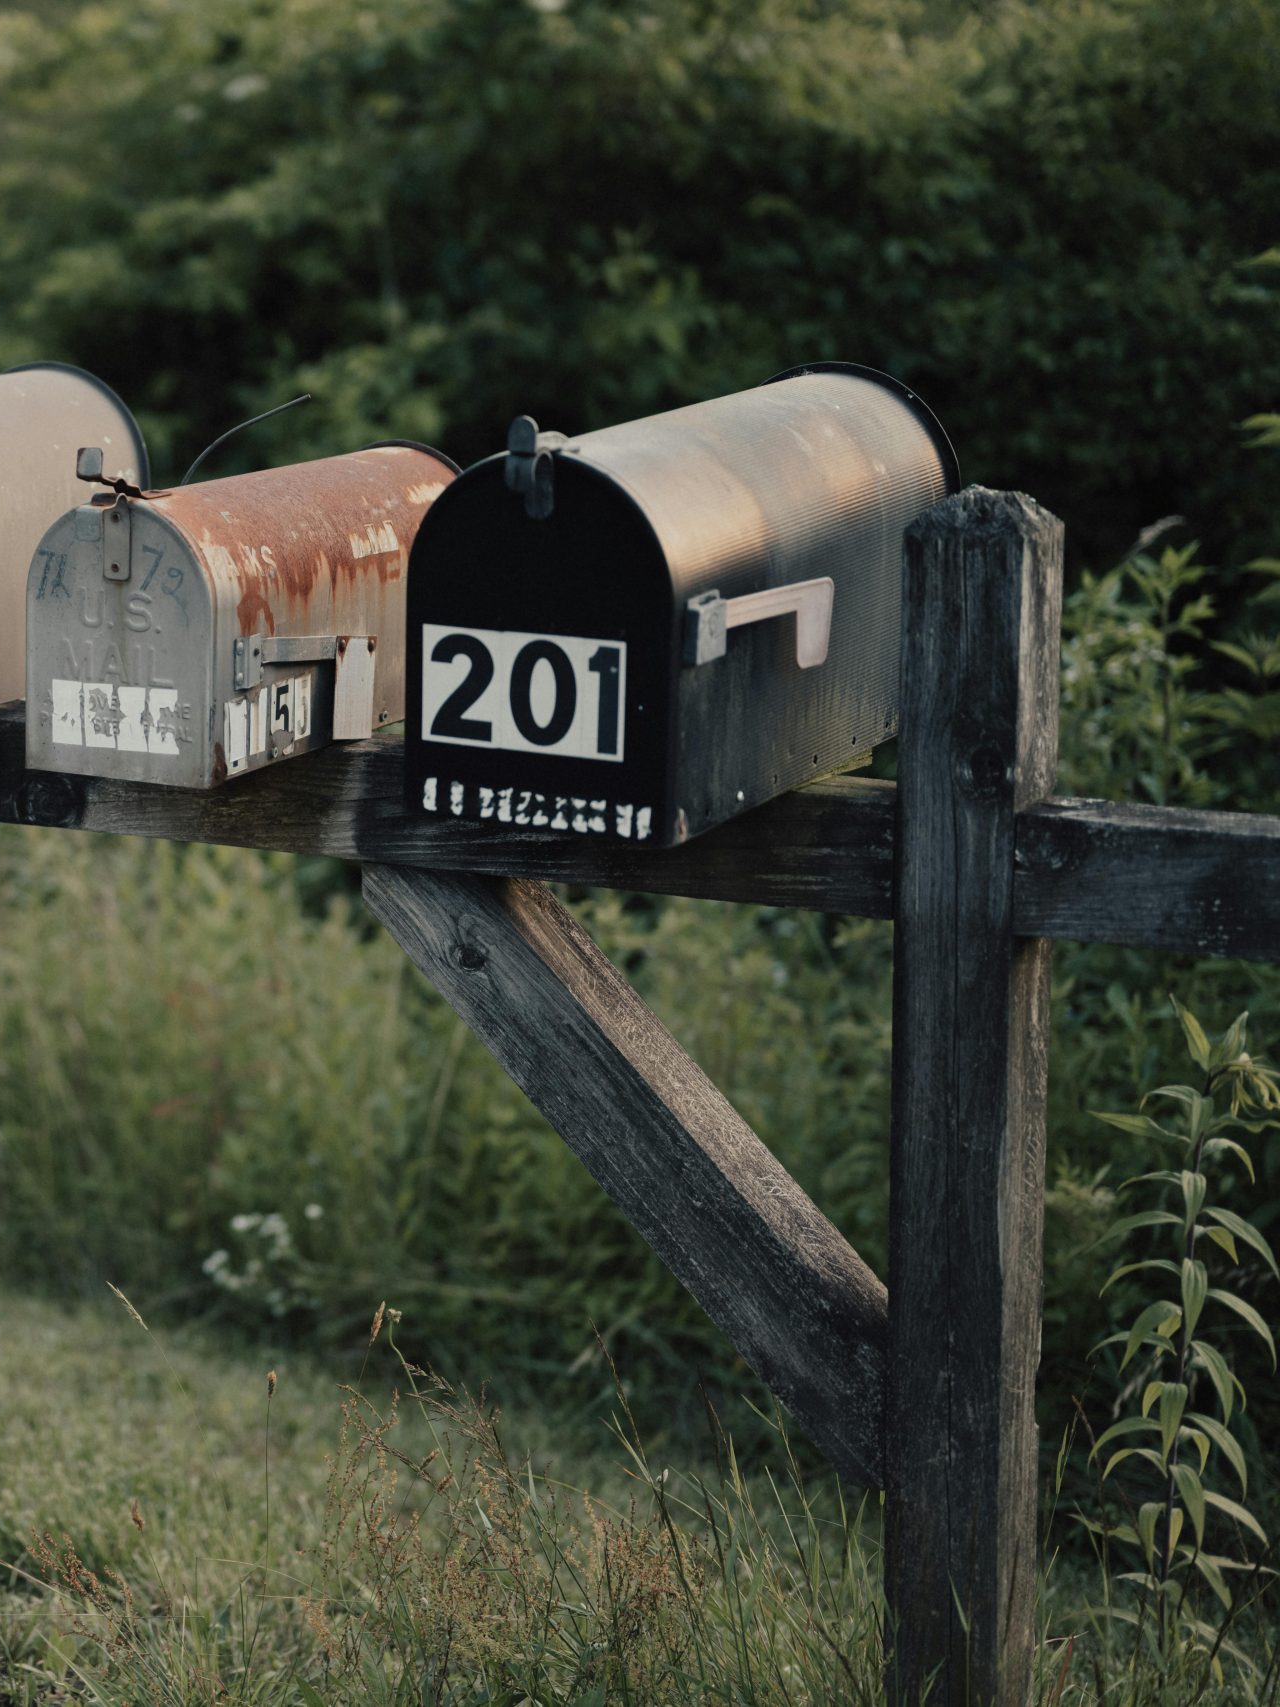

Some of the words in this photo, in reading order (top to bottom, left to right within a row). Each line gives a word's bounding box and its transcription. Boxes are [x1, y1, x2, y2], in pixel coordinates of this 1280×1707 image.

[80, 586, 162, 632] U.S.
[60, 637, 175, 689] MAIL
[429, 632, 619, 756] 201
